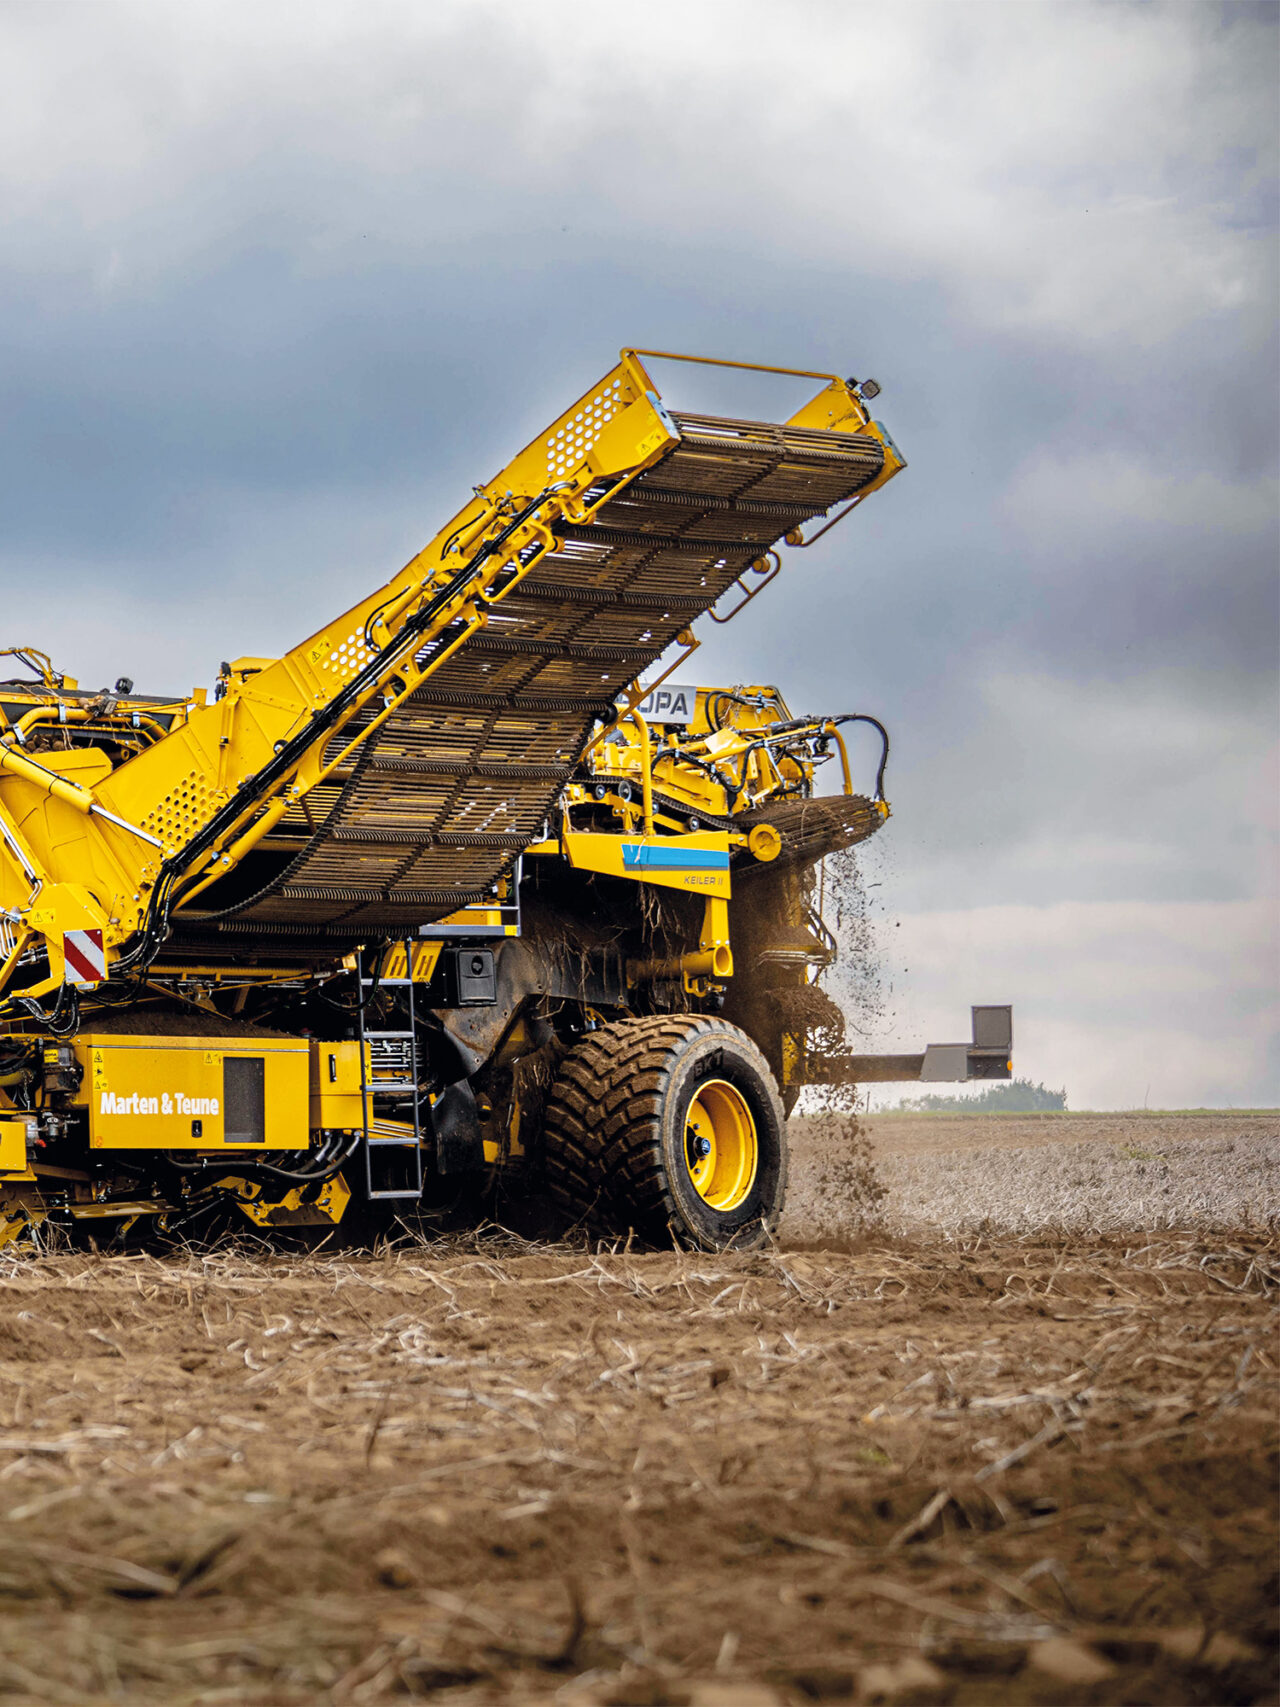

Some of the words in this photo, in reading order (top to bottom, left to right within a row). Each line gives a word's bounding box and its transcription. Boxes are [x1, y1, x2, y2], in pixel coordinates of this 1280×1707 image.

[616, 691, 688, 718] OPA
[684, 875, 716, 885] KEILER
[694, 1046, 724, 1081] BKT
[100, 1091, 159, 1115] Marten
[160, 1092, 174, 1114] &
[174, 1092, 220, 1116] Teune
